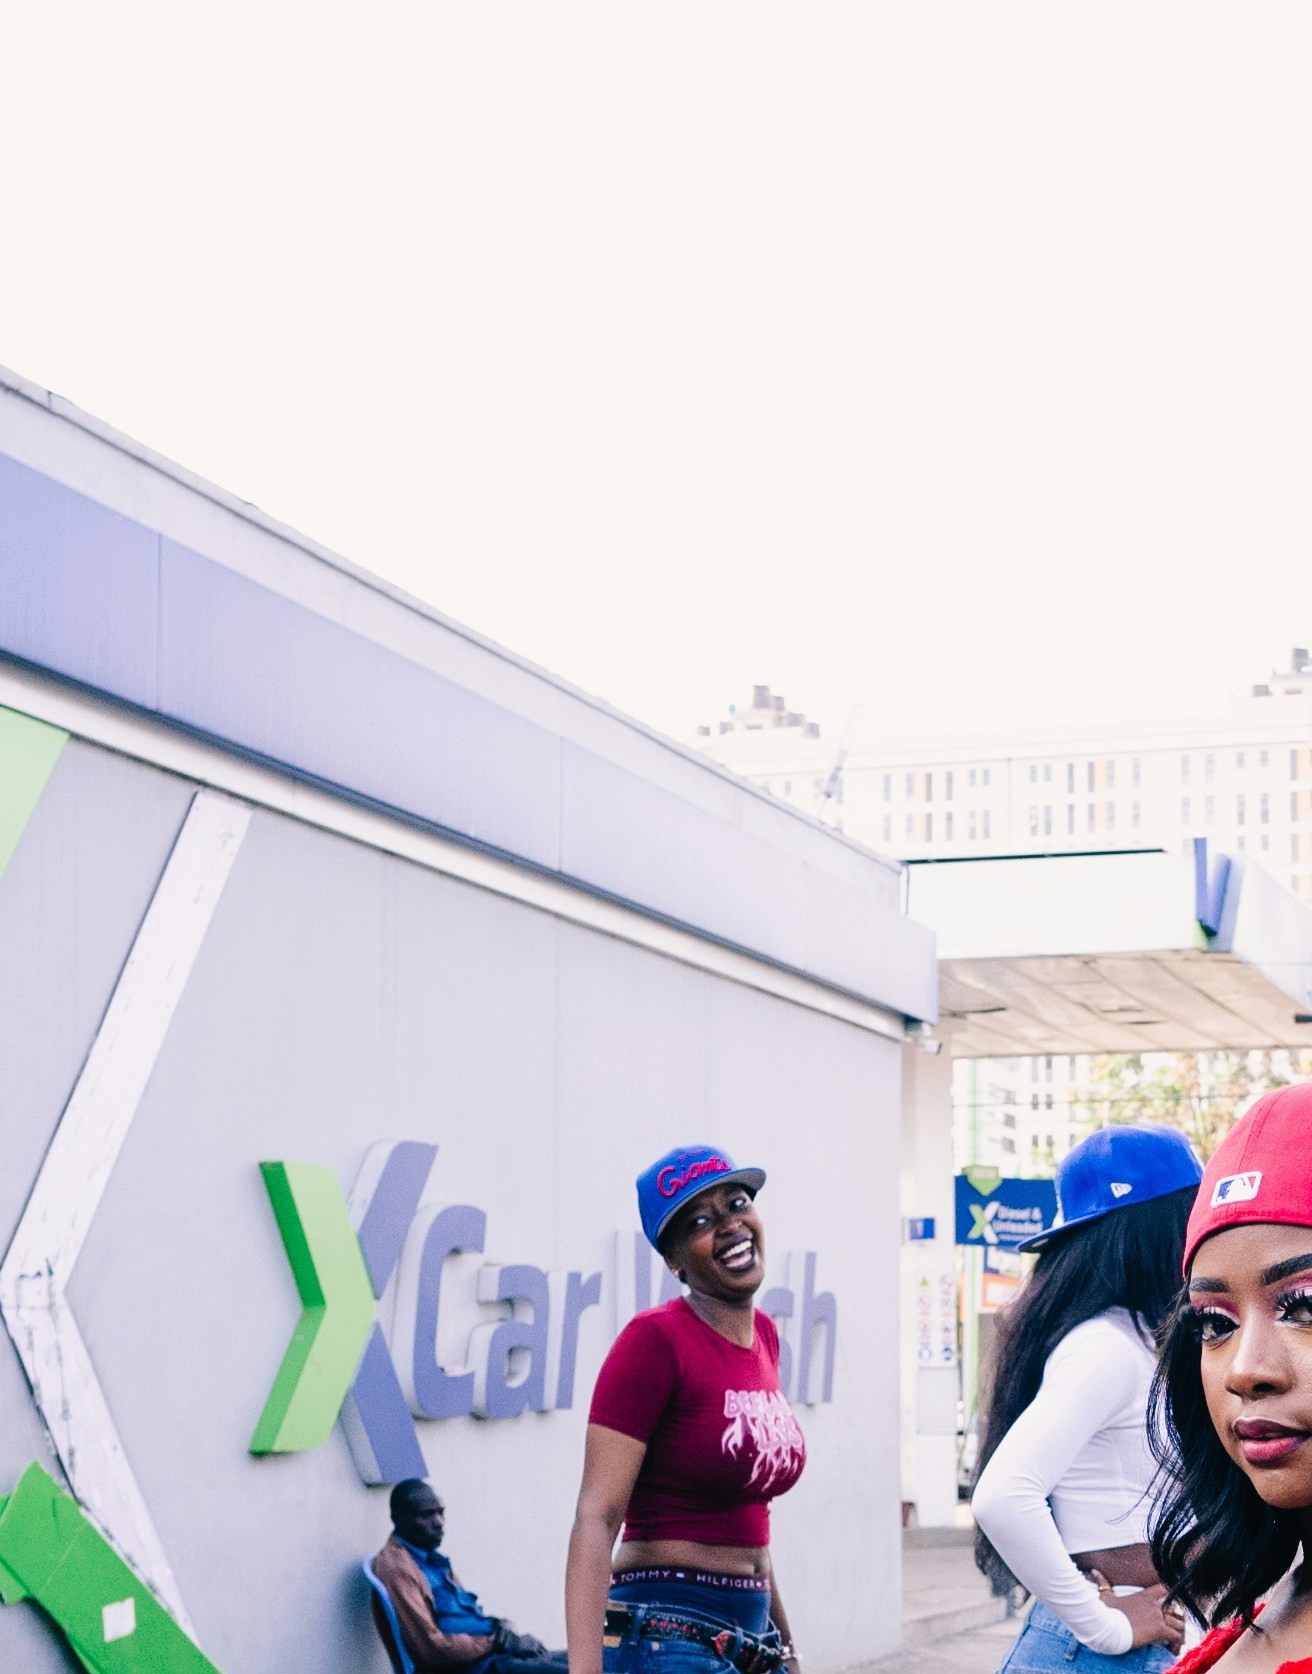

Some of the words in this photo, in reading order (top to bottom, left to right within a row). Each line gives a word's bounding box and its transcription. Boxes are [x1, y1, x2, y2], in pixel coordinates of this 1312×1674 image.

[657, 1156, 731, 1198] Giants
[413, 1204, 602, 1419] Car
[621, 1570, 671, 1582] TOMMY
[696, 1574, 755, 1588] HILFIGER
